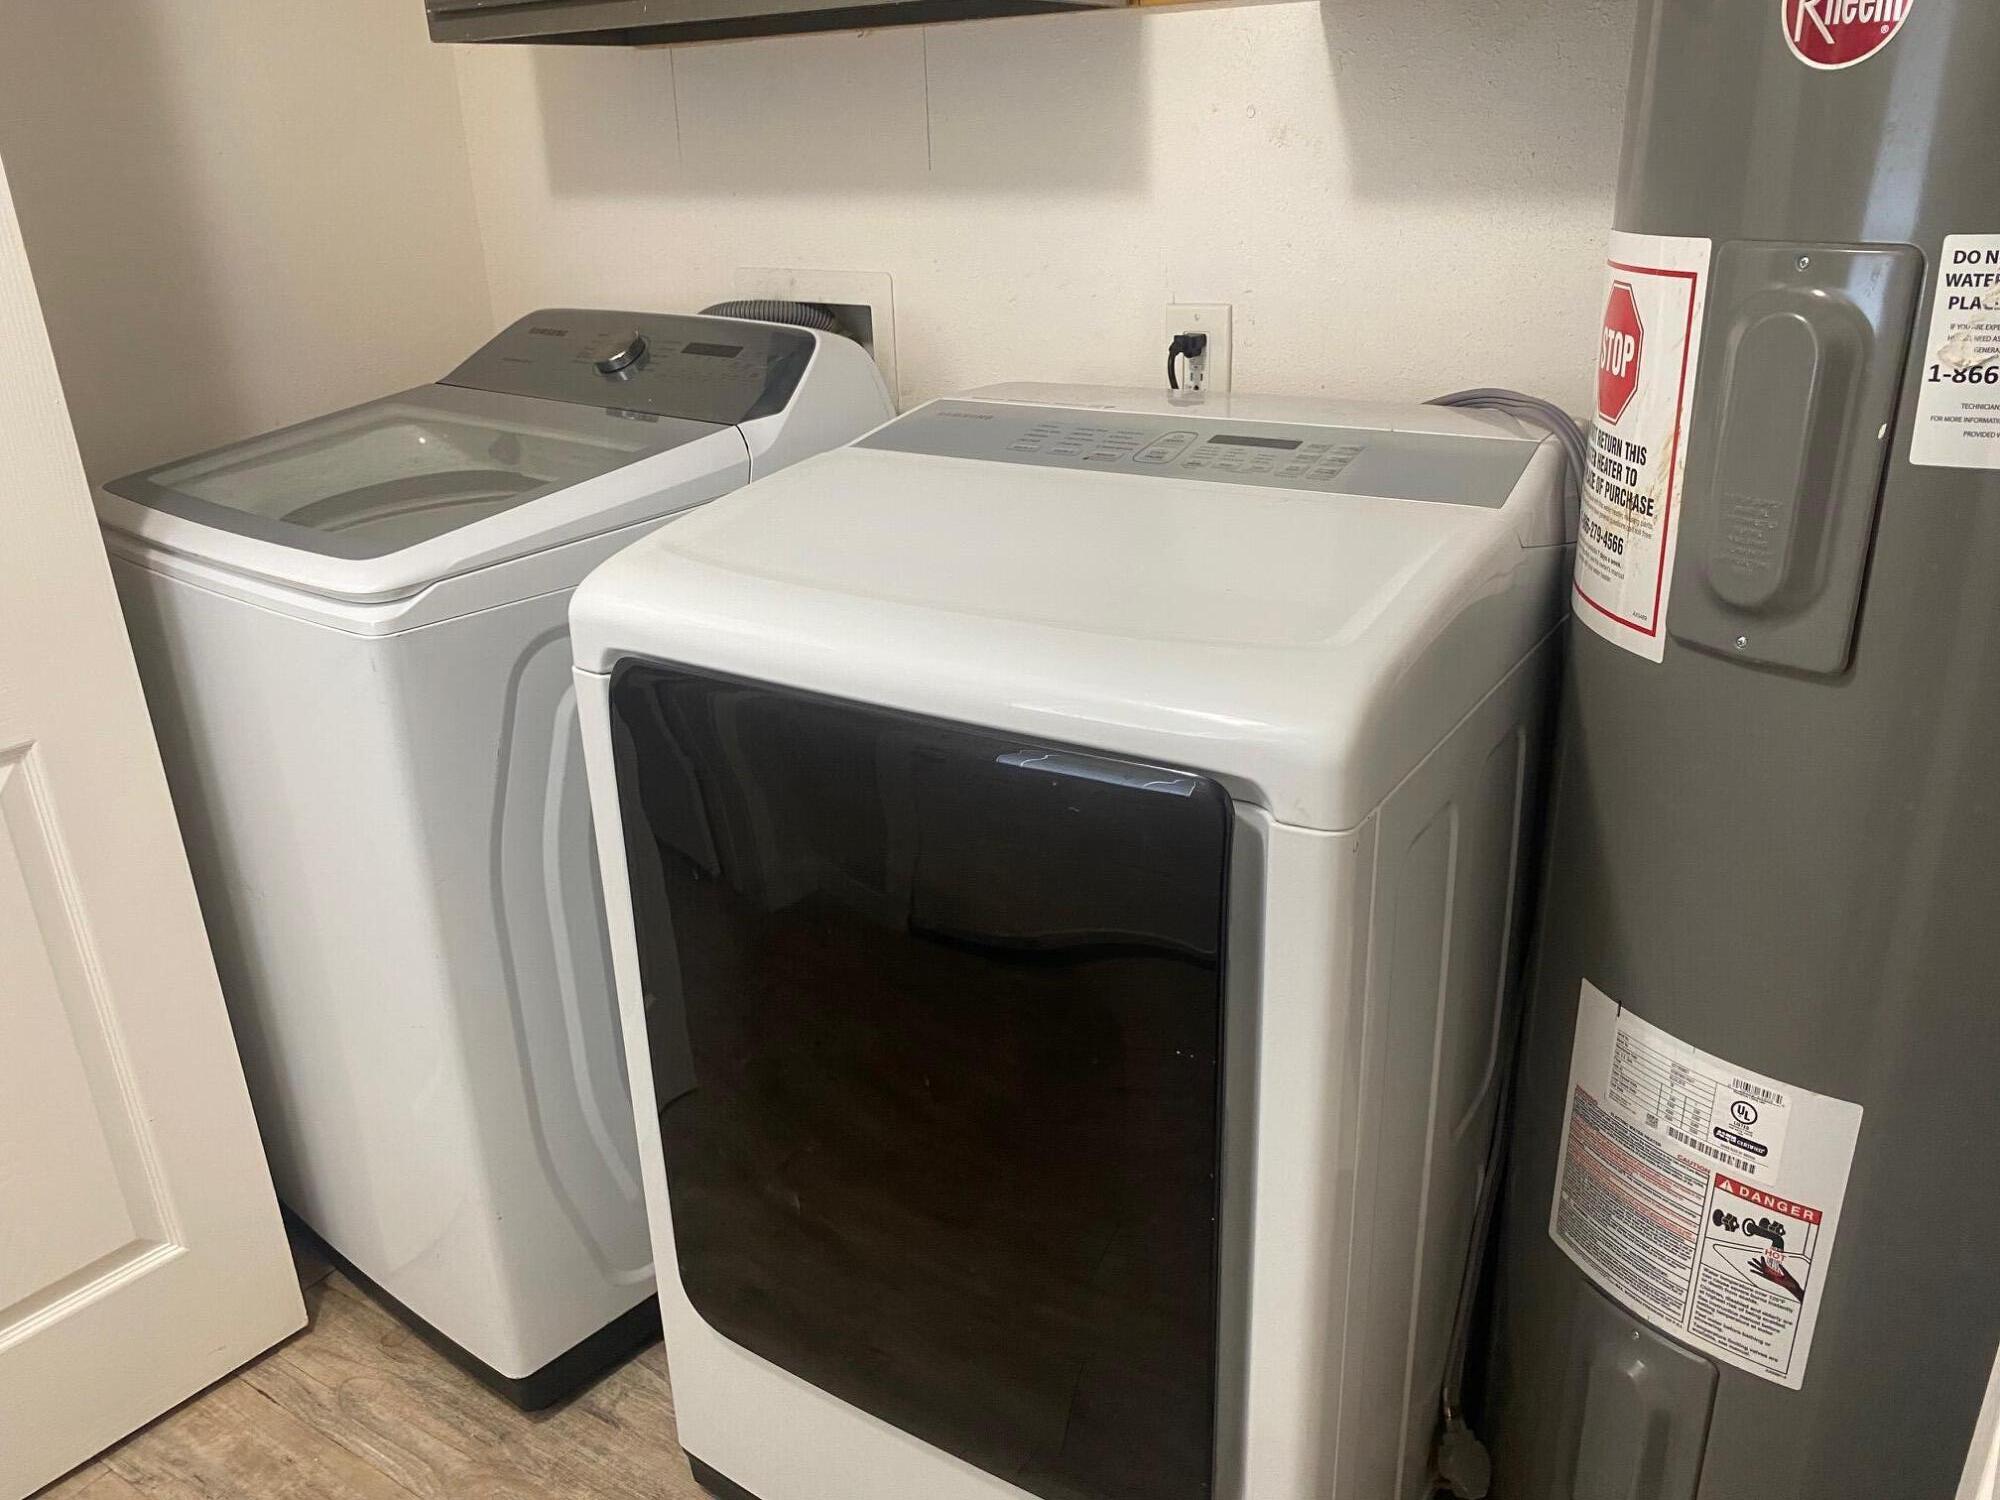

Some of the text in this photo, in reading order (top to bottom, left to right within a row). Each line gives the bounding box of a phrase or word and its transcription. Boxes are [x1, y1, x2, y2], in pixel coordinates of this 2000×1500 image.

[1953, 250, 1981, 264] DO
[1600, 326, 1635, 378] STOP
[1928, 364, 1999, 384] 1-866
[1597, 429, 1623, 457] RETURN
[1625, 441, 1647, 465] THIS
[1597, 453, 1622, 481] HEATER
[1626, 467, 1637, 487] TO
[1605, 480, 1654, 517] PURCHASE
[1737, 1104, 1750, 1121] UL
[1677, 1154, 1711, 1173] CAUTION
[1740, 1187, 1814, 1220] DANGER
[1765, 1249, 1786, 1261] HOT
